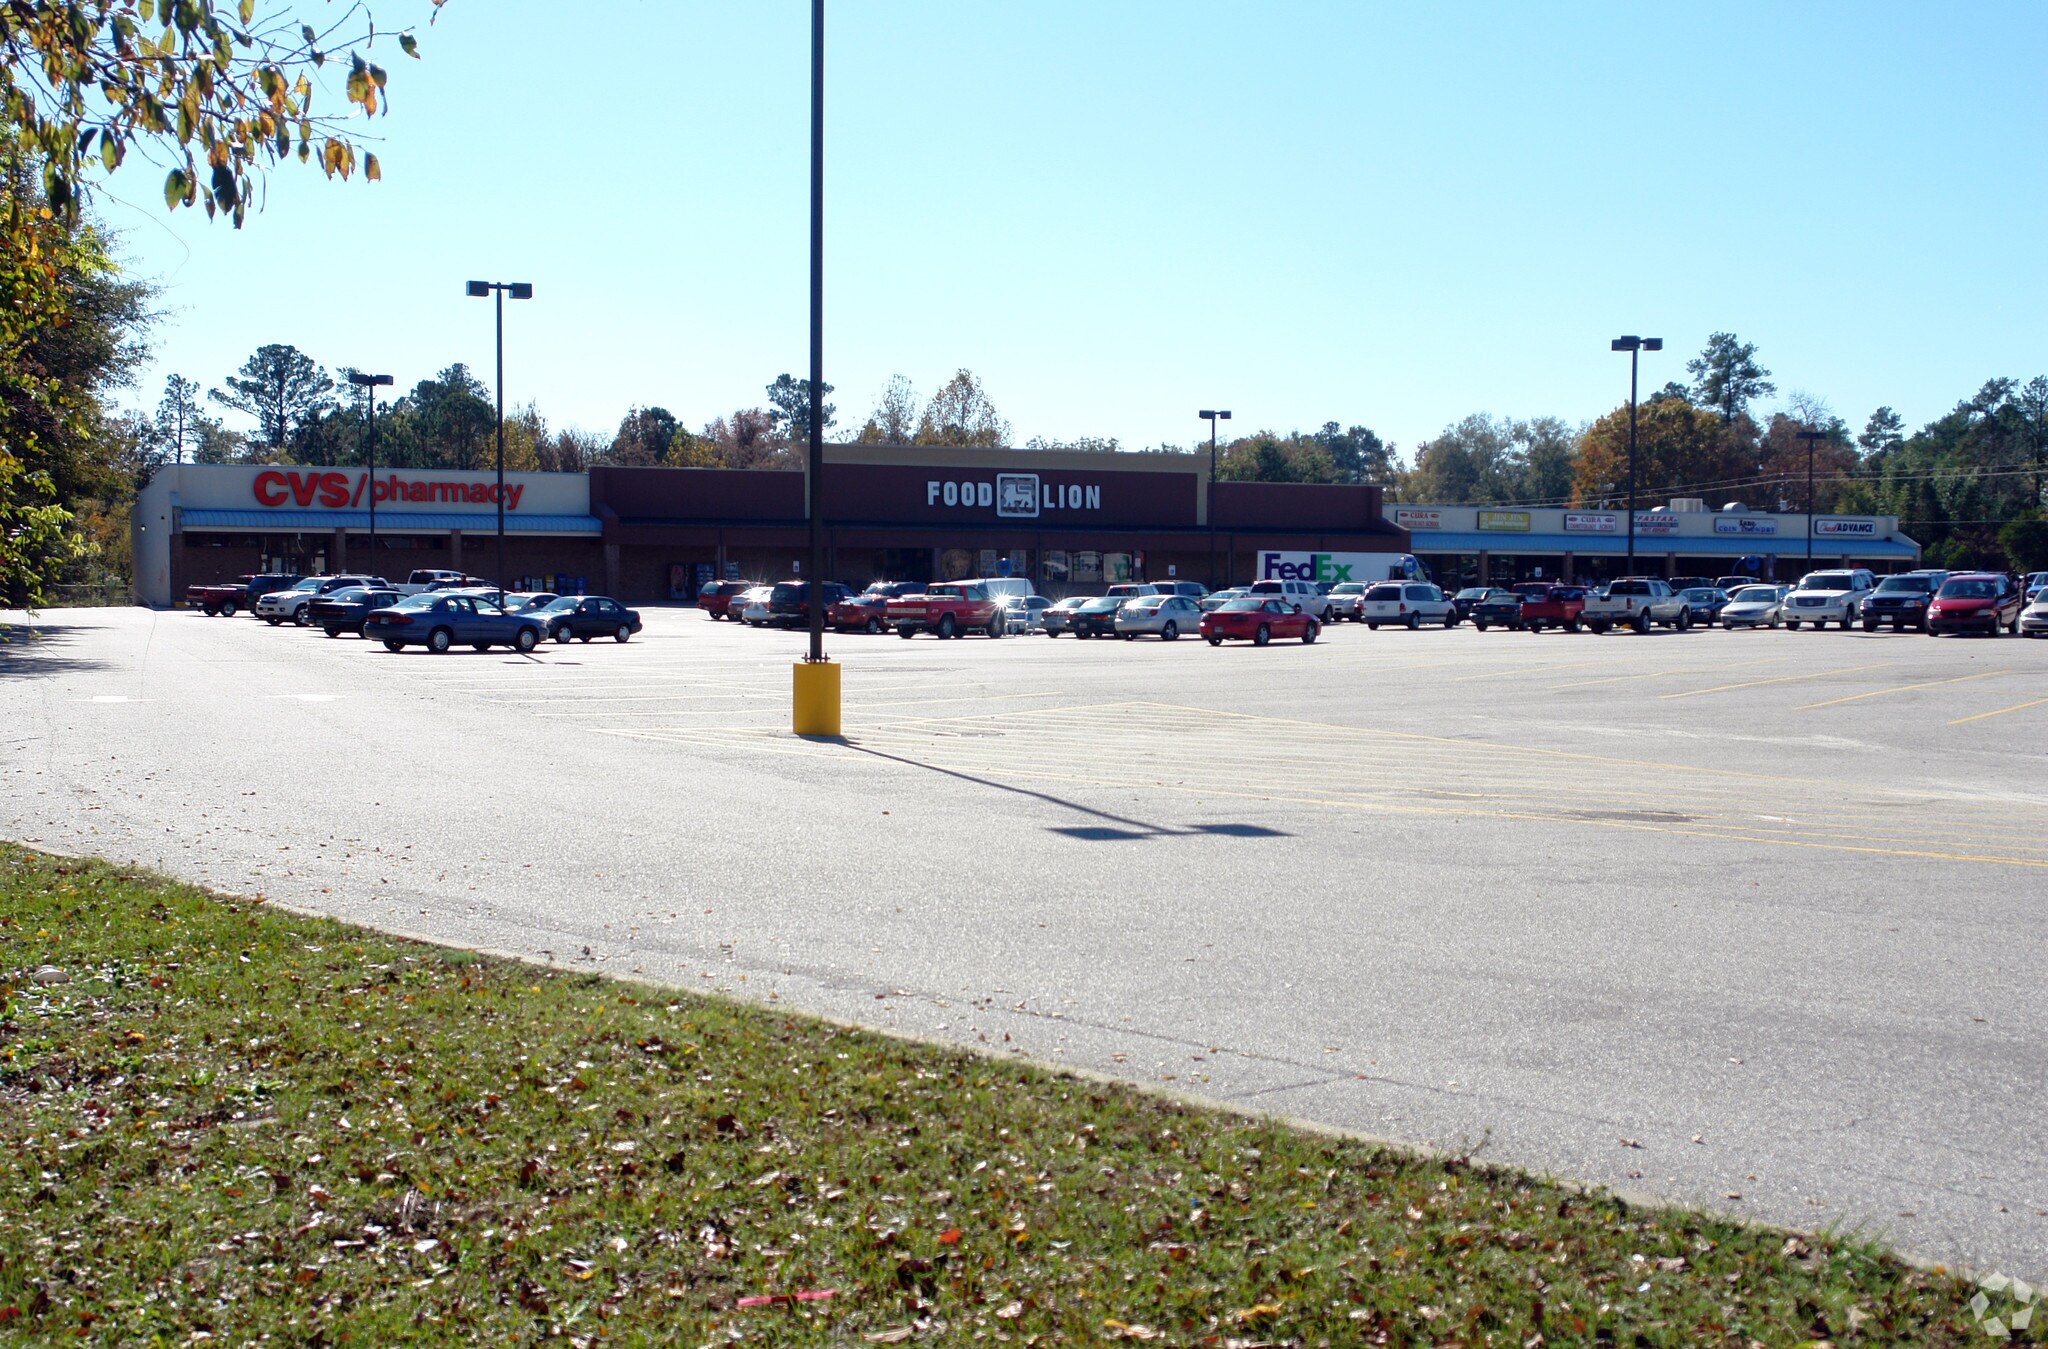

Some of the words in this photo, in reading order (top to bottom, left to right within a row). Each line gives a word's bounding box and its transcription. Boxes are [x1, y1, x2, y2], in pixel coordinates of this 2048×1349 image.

[253, 471, 524, 510] CVS/pharmacy
[927, 481, 993, 507] FOOD
[1043, 484, 1100, 509] LION
[1837, 523, 1873, 533] ADVANCE
[1264, 553, 1354, 581] FedEx
